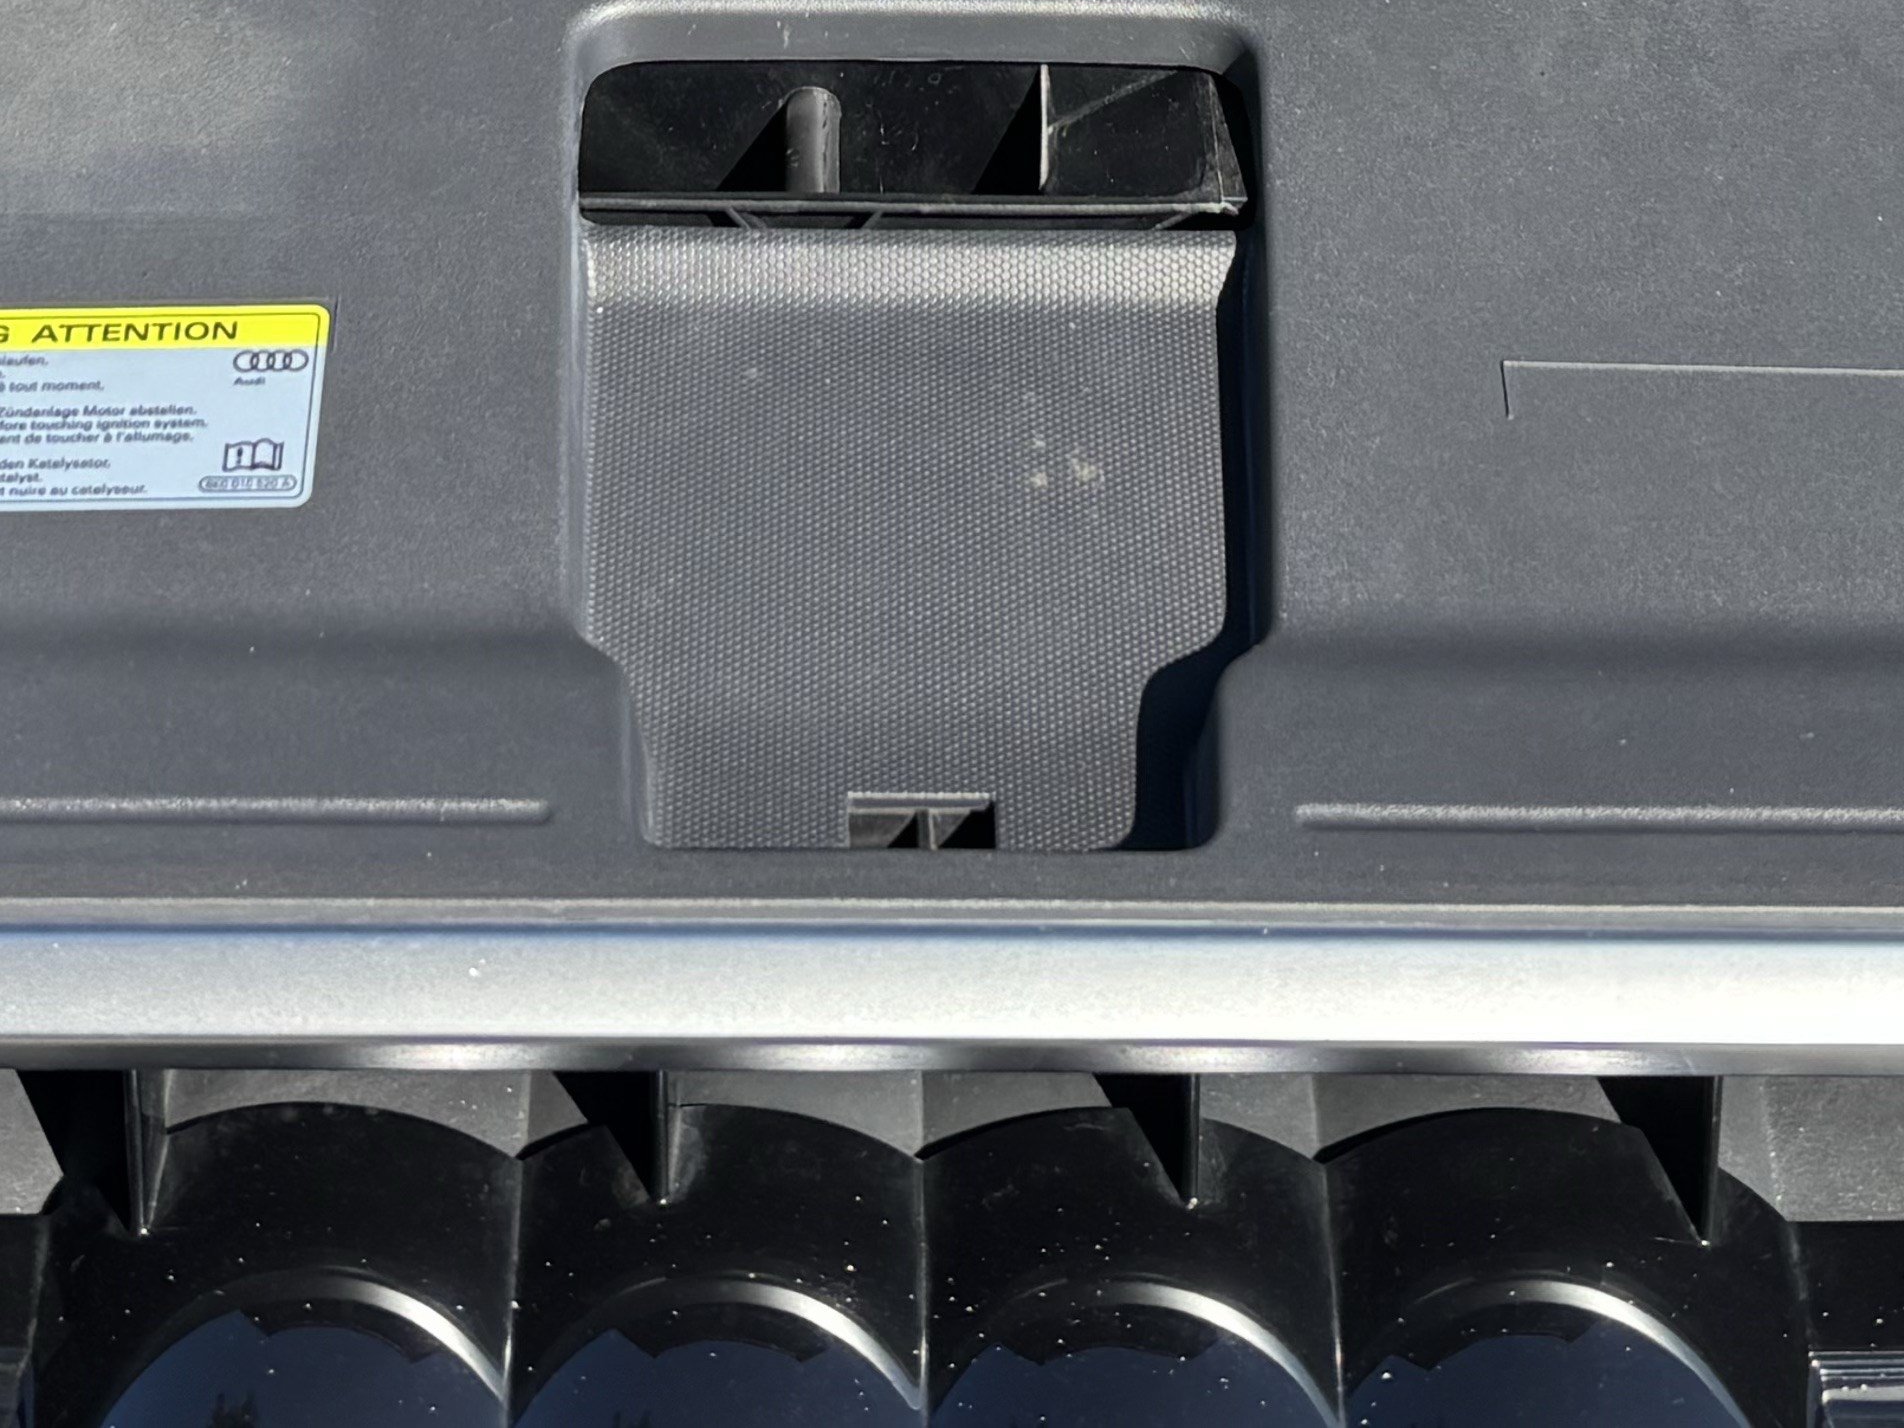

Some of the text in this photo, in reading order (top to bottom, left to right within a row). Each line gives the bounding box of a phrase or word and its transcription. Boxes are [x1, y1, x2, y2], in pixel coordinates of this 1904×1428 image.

[31, 321, 238, 344] ATTENTION
[9, 380, 38, 391] tout
[233, 377, 266, 385] Audi
[83, 404, 126, 416] Motor
[30, 416, 93, 432] touching
[96, 417, 150, 430] ignition
[25, 432, 41, 443] de
[46, 432, 100, 443] toucher
[10, 485, 46, 496] nuire
[51, 486, 68, 496] au
